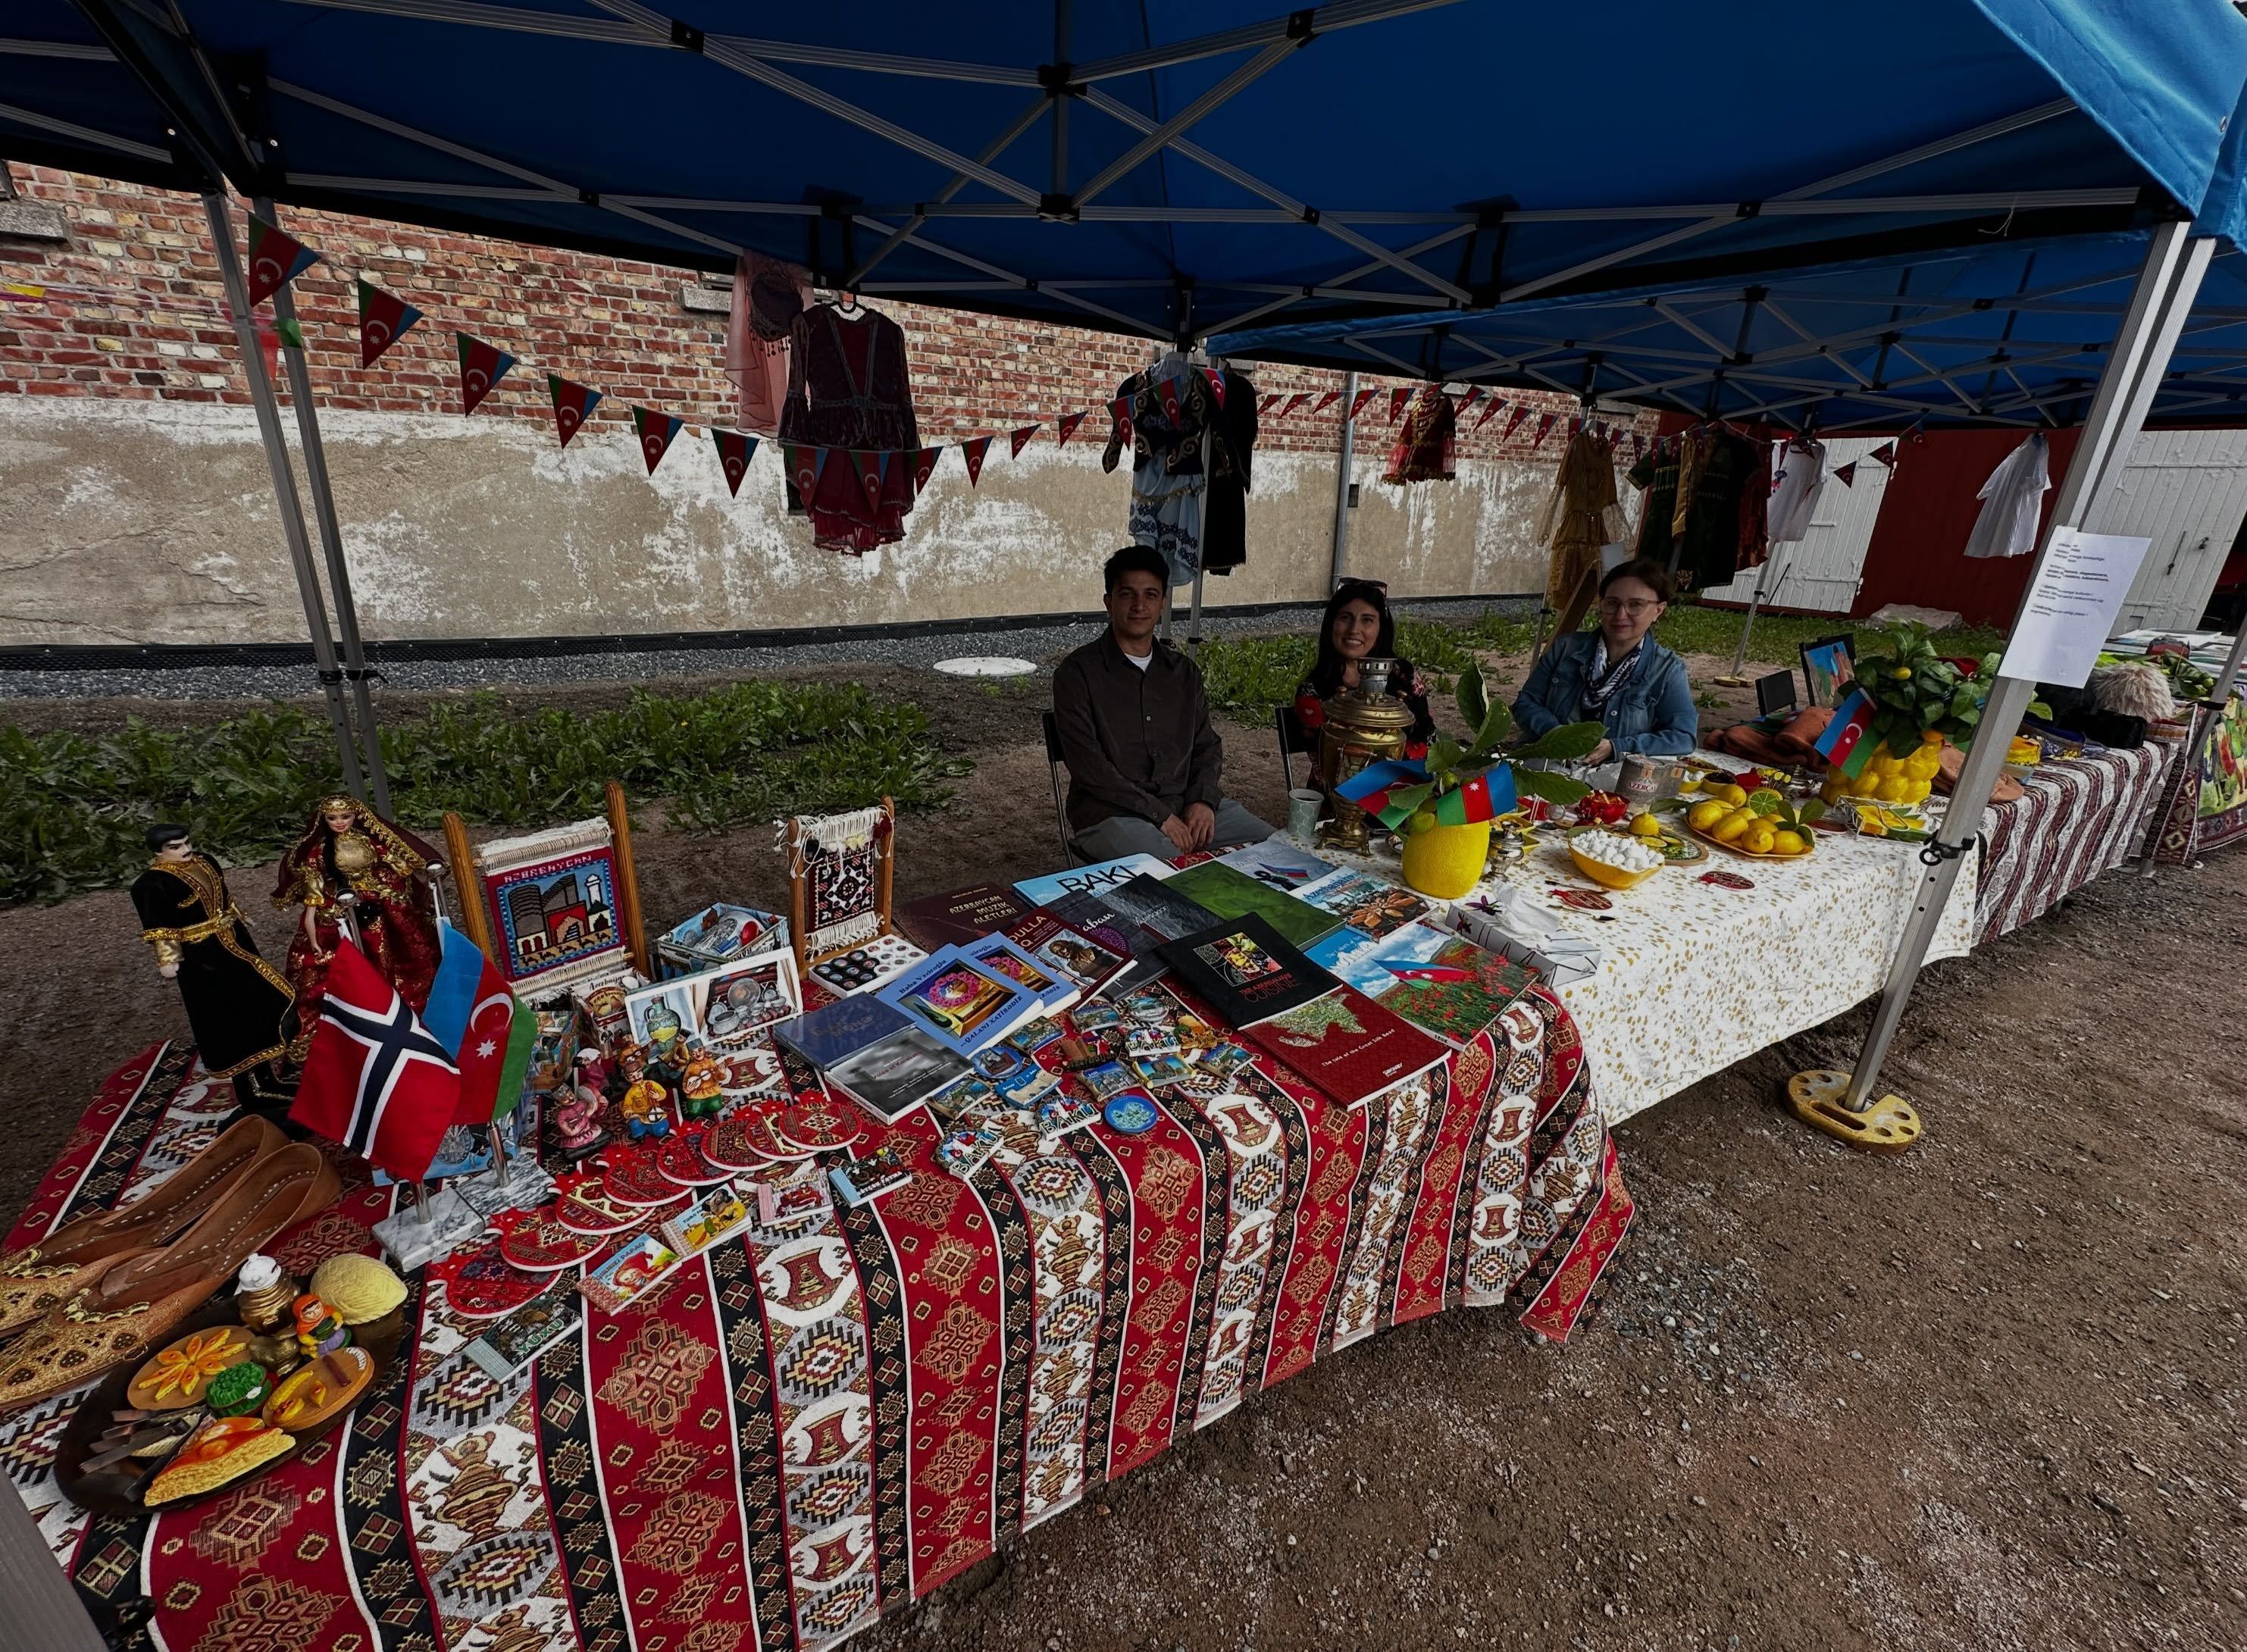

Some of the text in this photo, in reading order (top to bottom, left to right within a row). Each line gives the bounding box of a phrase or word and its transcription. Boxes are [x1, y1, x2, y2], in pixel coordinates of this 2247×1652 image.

[950, 895, 1003, 914] AZERBAYCAN
[1126, 1036, 1180, 1052] BAKU
[1041, 1103, 1098, 1134] BAKU
[953, 1126, 1003, 1175] BAKU
